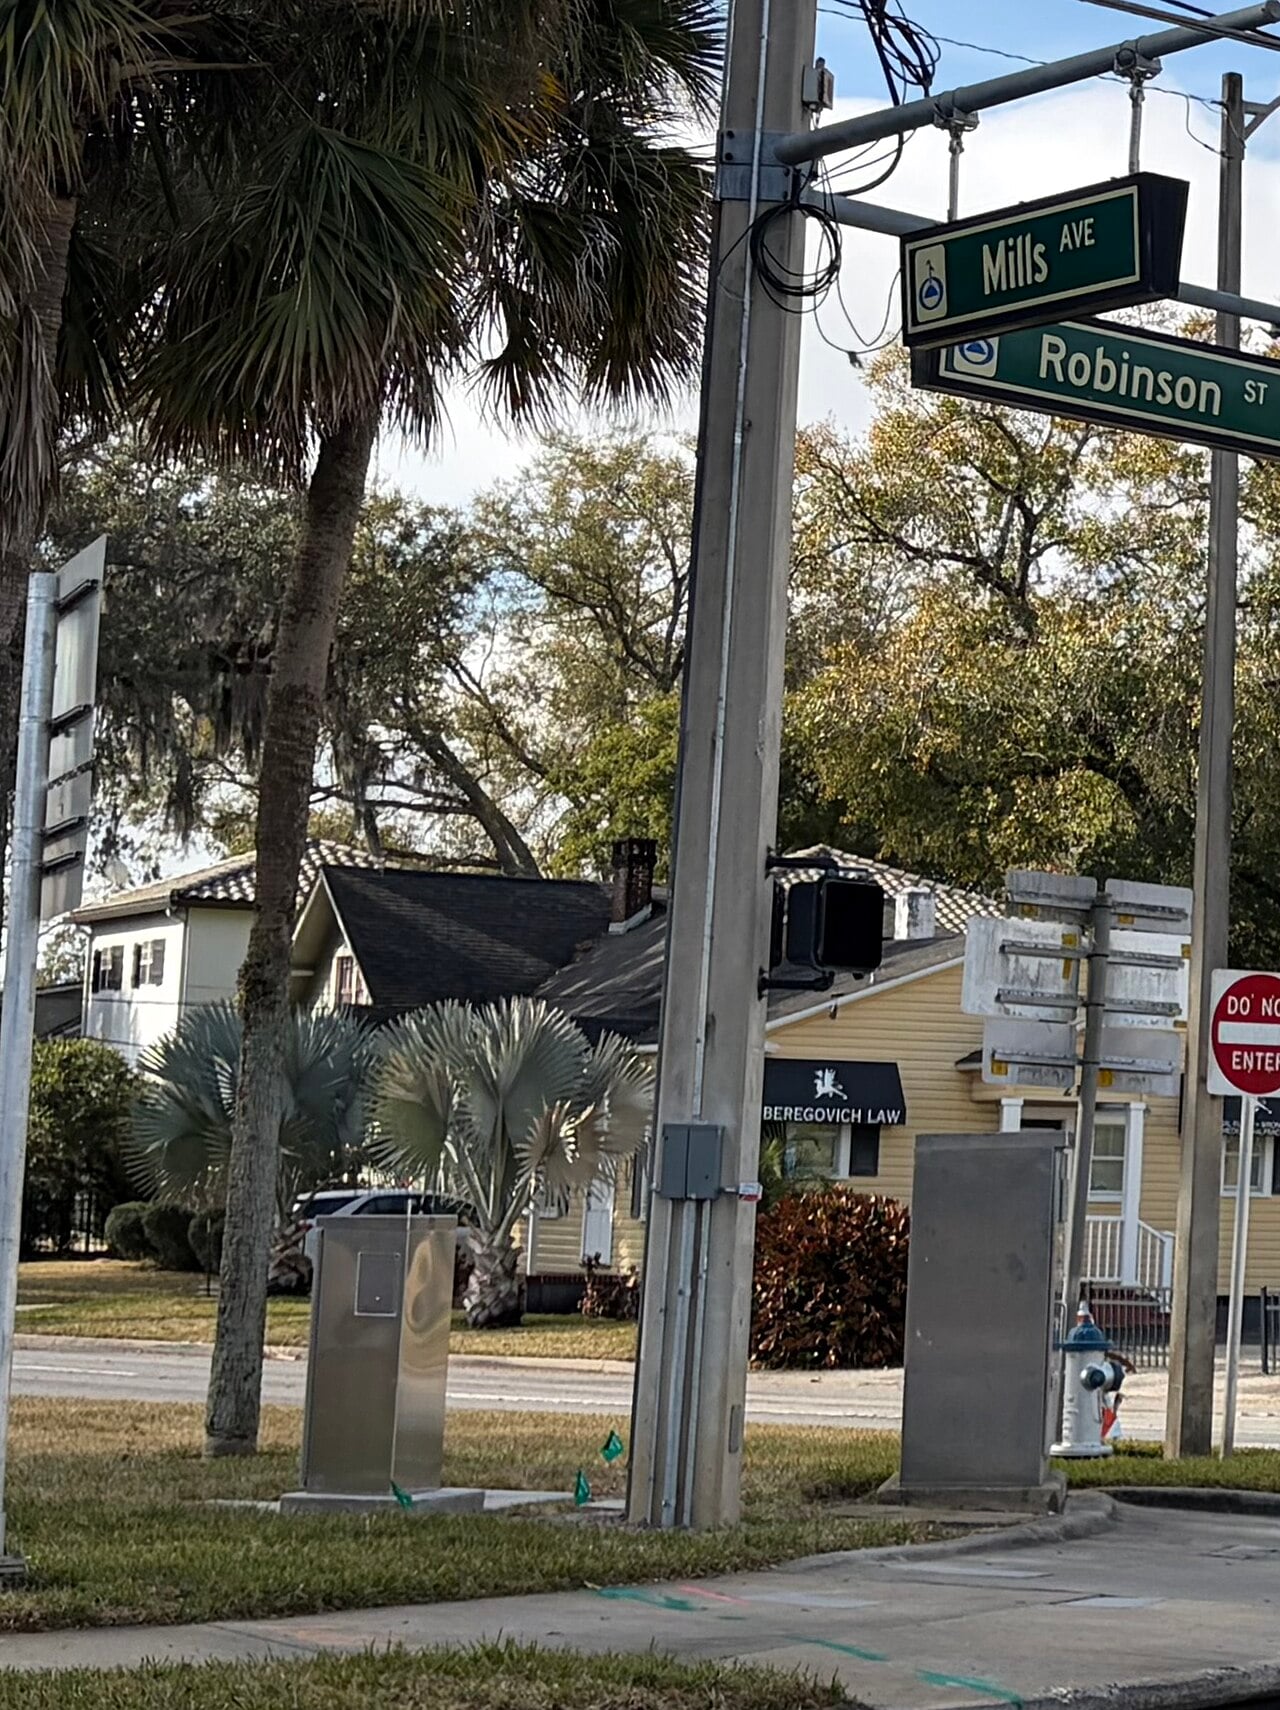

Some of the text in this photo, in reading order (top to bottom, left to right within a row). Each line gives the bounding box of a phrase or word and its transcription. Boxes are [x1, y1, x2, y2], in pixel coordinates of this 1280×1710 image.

[982, 217, 1095, 295] Mills AVE
[1039, 333, 1268, 416] Robinson ST
[1227, 995, 1251, 1016] DO
[763, 1106, 901, 1125] BEREGOVICH LAW
